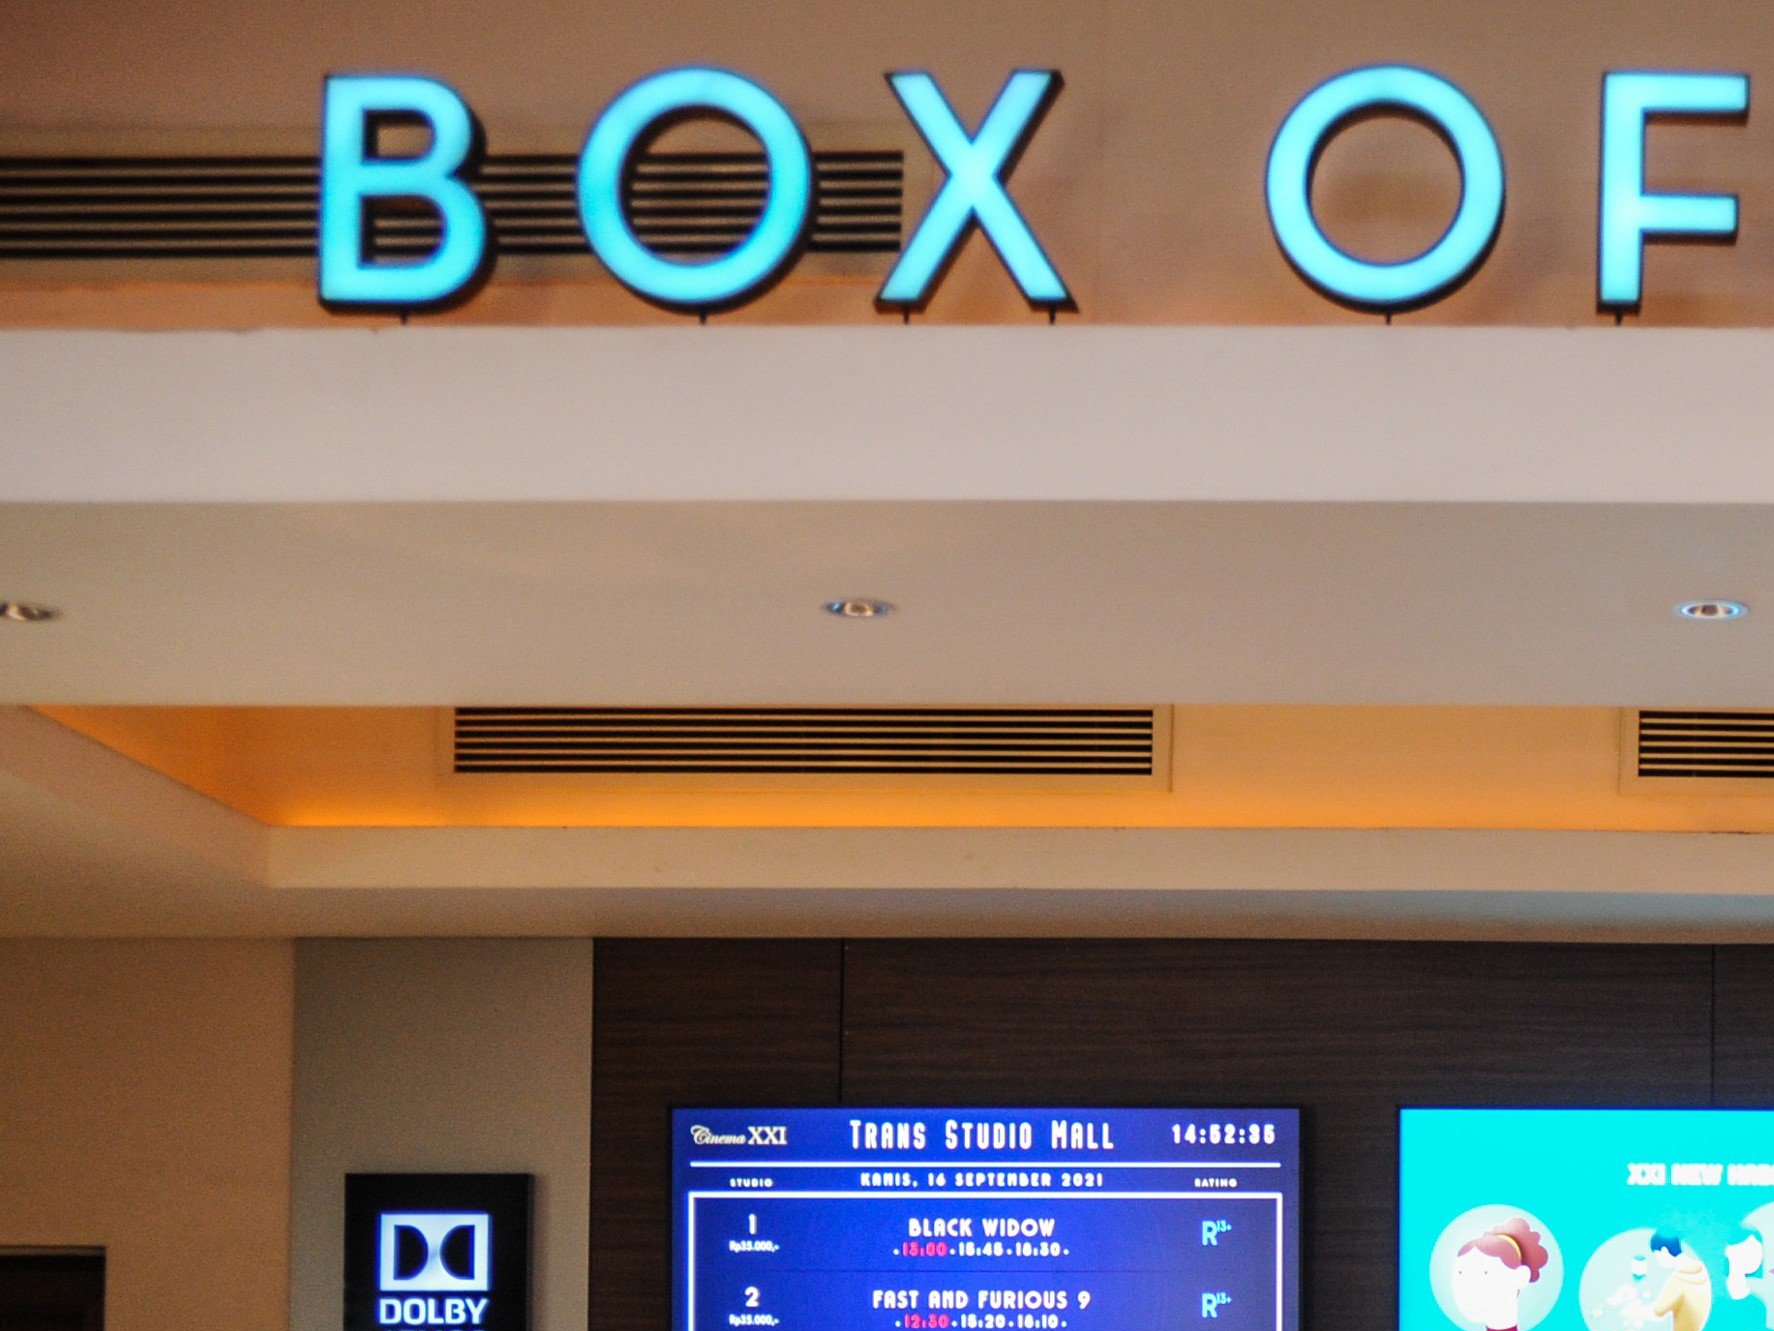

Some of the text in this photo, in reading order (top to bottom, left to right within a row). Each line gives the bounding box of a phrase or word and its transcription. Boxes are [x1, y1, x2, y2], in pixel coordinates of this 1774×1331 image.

[317, 66, 1077, 312] BOX
[690, 1125, 788, 1146] Cinema XXI
[850, 1120, 1114, 1150] TRANS STUDIO MALL
[729, 1177, 773, 1188] STUDIO
[928, 1172, 946, 1187] 16
[955, 1172, 1052, 1187] SEPTEMBER
[1061, 1172, 1103, 1187] 2021
[1194, 1178, 1238, 1188] RATING
[1627, 1163, 1667, 1186] XXI
[748, 1213, 757, 1235] 1
[908, 1218, 1056, 1237] BLACK WIDOW
[744, 1286, 760, 1307] 2
[872, 1289, 1091, 1309] FAST AND FURIOUS 9
[379, 1298, 489, 1325] DOLBY
